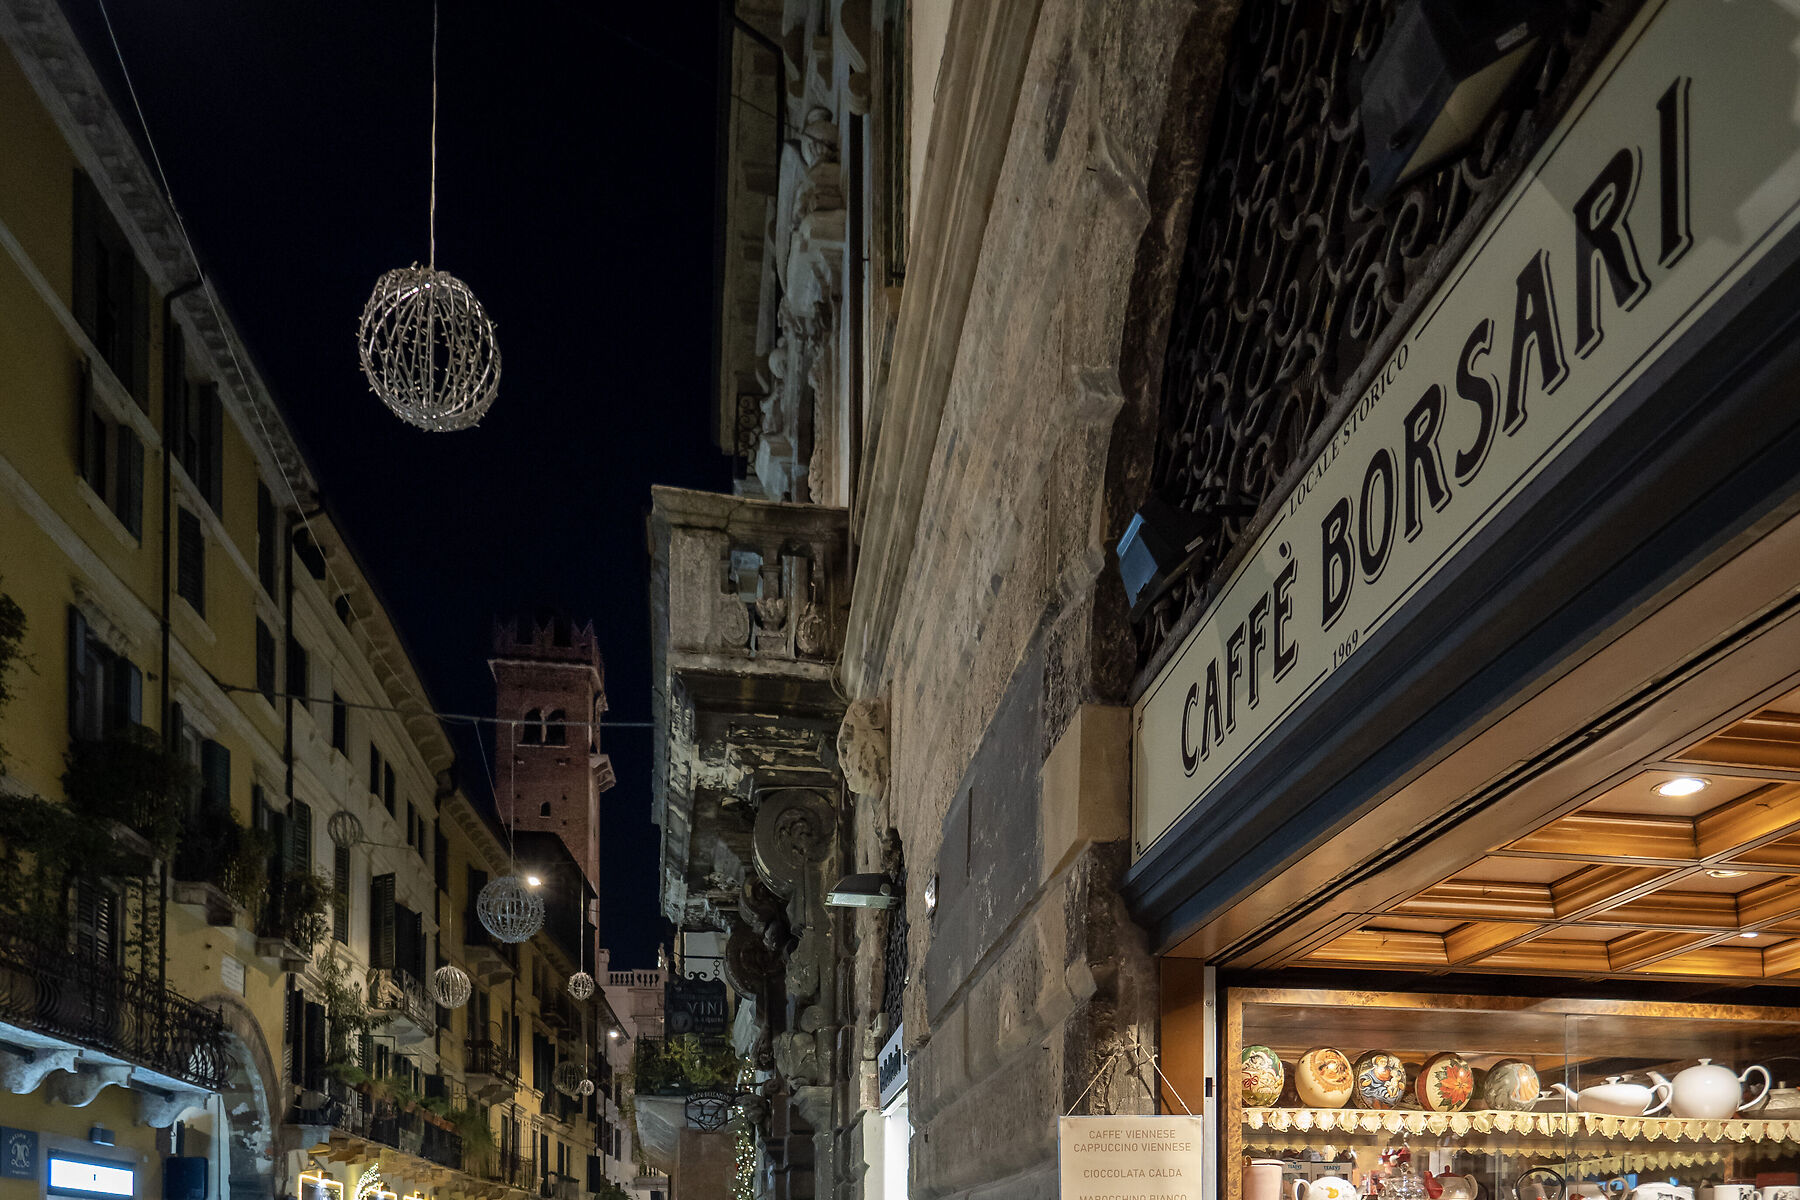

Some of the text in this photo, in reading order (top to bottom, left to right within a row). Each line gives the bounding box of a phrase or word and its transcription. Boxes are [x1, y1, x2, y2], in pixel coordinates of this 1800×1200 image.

[1320, 75, 1694, 633] BORSARI
[1289, 343, 1409, 518] LOCALE STORICO
[1332, 629, 1359, 670] 1969
[687, 1000, 724, 1016] VINI
[1088, 1129, 1176, 1139] CAFFE' VIENNESE
[1073, 1142, 1191, 1153] CAPPUCCINO VIENNESE
[1083, 1168, 1182, 1178] CIOCCOLATA CALDA
